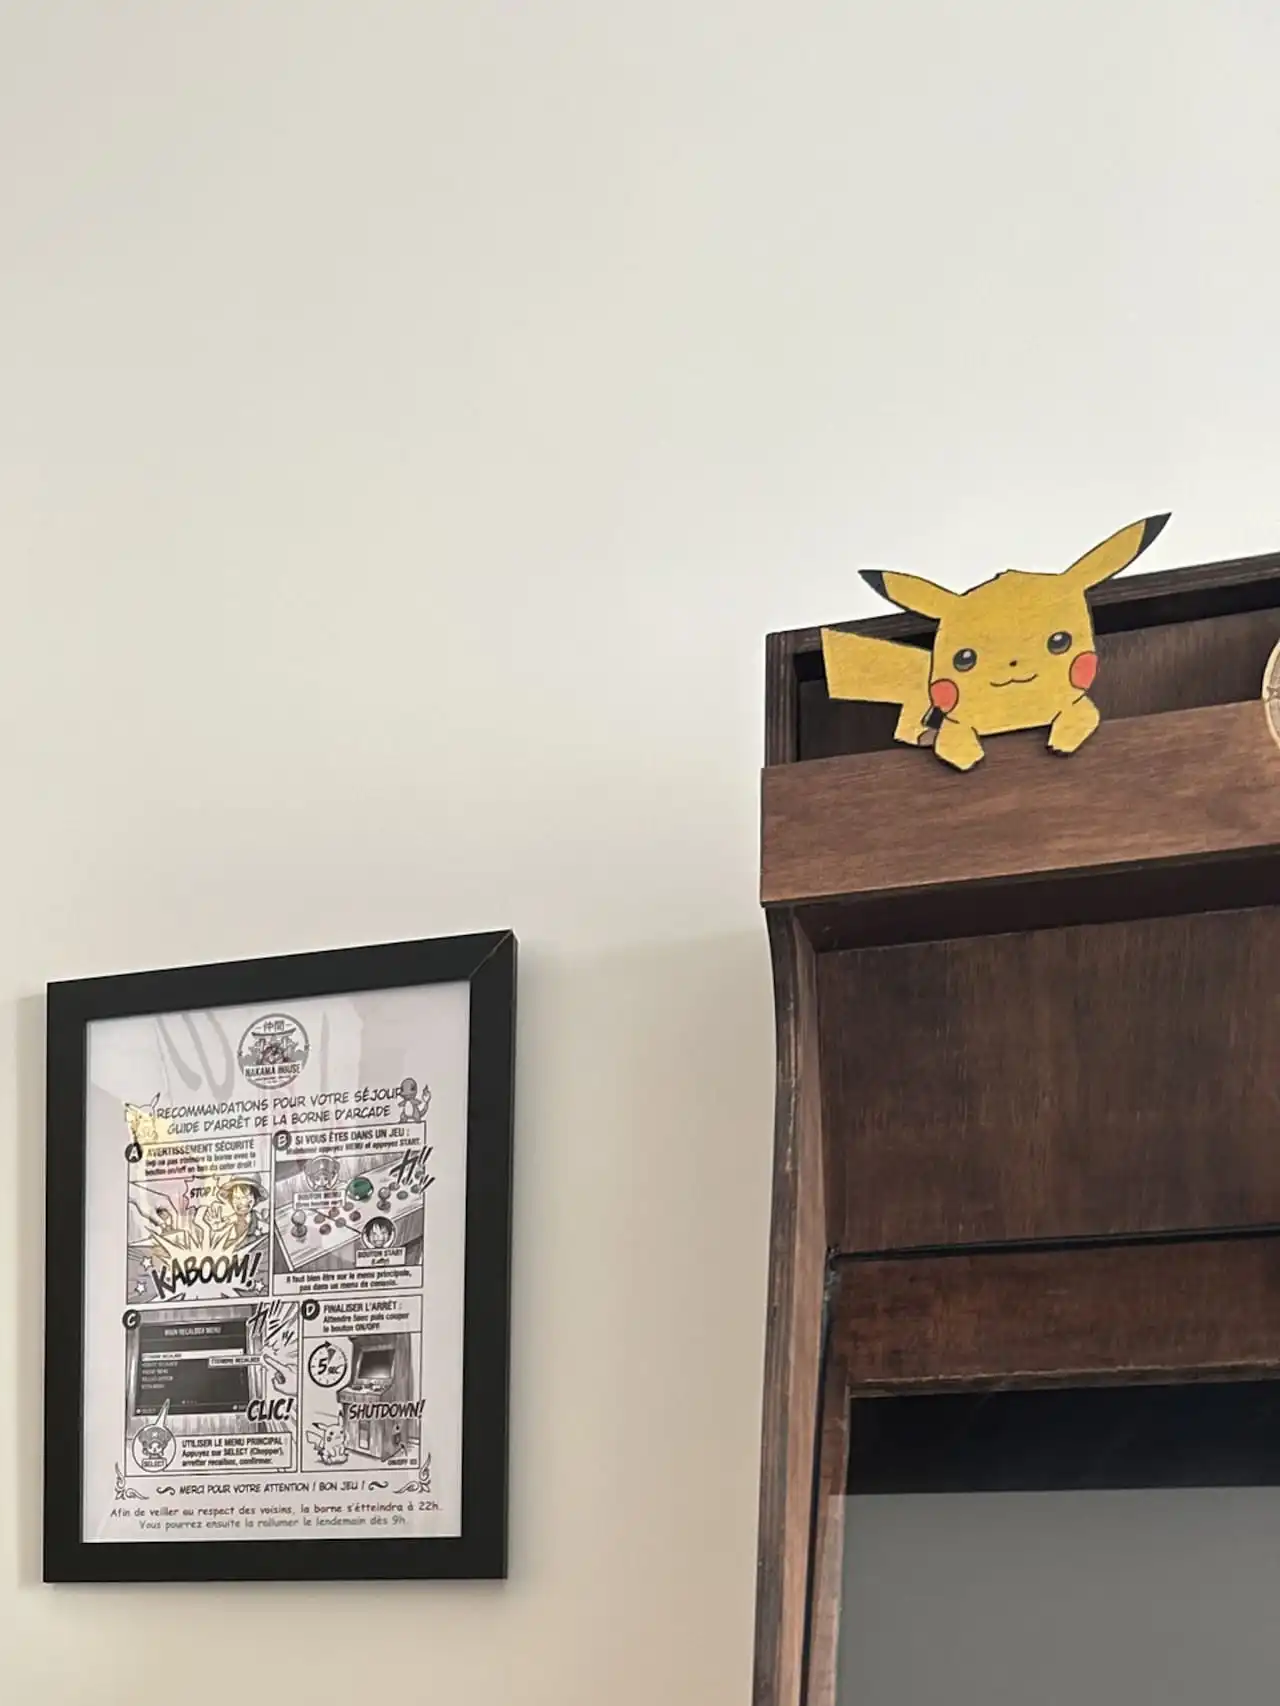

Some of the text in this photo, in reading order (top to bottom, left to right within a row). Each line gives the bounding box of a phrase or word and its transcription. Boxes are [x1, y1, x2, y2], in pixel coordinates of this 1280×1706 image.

[245, 1064, 301, 1077] NAKAMA HOUSE
[157, 1086, 402, 1119] RECOMMANDATIONS POUR VOTRE SÉJOUR
[167, 1105, 391, 1135] GUIDE D'ARRÊT DE LA BORNE D'ARCADE
[277, 1134, 288, 1146] B
[295, 1135, 304, 1145] SI
[306, 1133, 327, 1144] VOUS
[329, 1130, 349, 1143] ÊTES
[351, 1129, 373, 1141] DANS
[375, 1129, 387, 1139] UN
[388, 1127, 405, 1138] JEU
[128, 1145, 140, 1160] A
[147, 1139, 254, 1158] AVERTISSEMENT SÉCURITÉ
[152, 1252, 261, 1299] KABOOM!
[306, 1303, 315, 1316] D
[323, 1303, 363, 1314] FINALISER
[365, 1300, 397, 1312] L'ARRÊT
[126, 1312, 137, 1326] C
[318, 1358, 328, 1375] 5
[247, 1399, 293, 1421] CLIC!
[349, 1399, 426, 1419] SHUTDOWN!
[182, 1439, 213, 1448] UTILISER
[214, 1438, 223, 1448] LE
[224, 1437, 245, 1447] MENU
[246, 1436, 282, 1446] PRINCIPAL
[179, 1484, 205, 1495] MERCI
[207, 1483, 231, 1494] POUR
[233, 1482, 261, 1494] VOTRE
[263, 1482, 309, 1493] ATTENTION
[320, 1481, 337, 1492] BON
[340, 1481, 359, 1491] JEU
[110, 1507, 130, 1518] Afin
[135, 1507, 145, 1517] de
[182, 1508, 194, 1516] au
[198, 1507, 235, 1518] respect
[238, 1505, 256, 1515] des
[301, 1503, 310, 1513] la
[314, 1503, 342, 1513] borne
[407, 1501, 414, 1512] à
[139, 1520, 161, 1530] Vous
[165, 1520, 202, 1532] pourrez
[205, 1519, 241, 1529] ensuite
[245, 1518, 254, 1528] la
[303, 1516, 312, 1526] le
[315, 1514, 366, 1526] lendemain
[370, 1514, 388, 1526] dès
